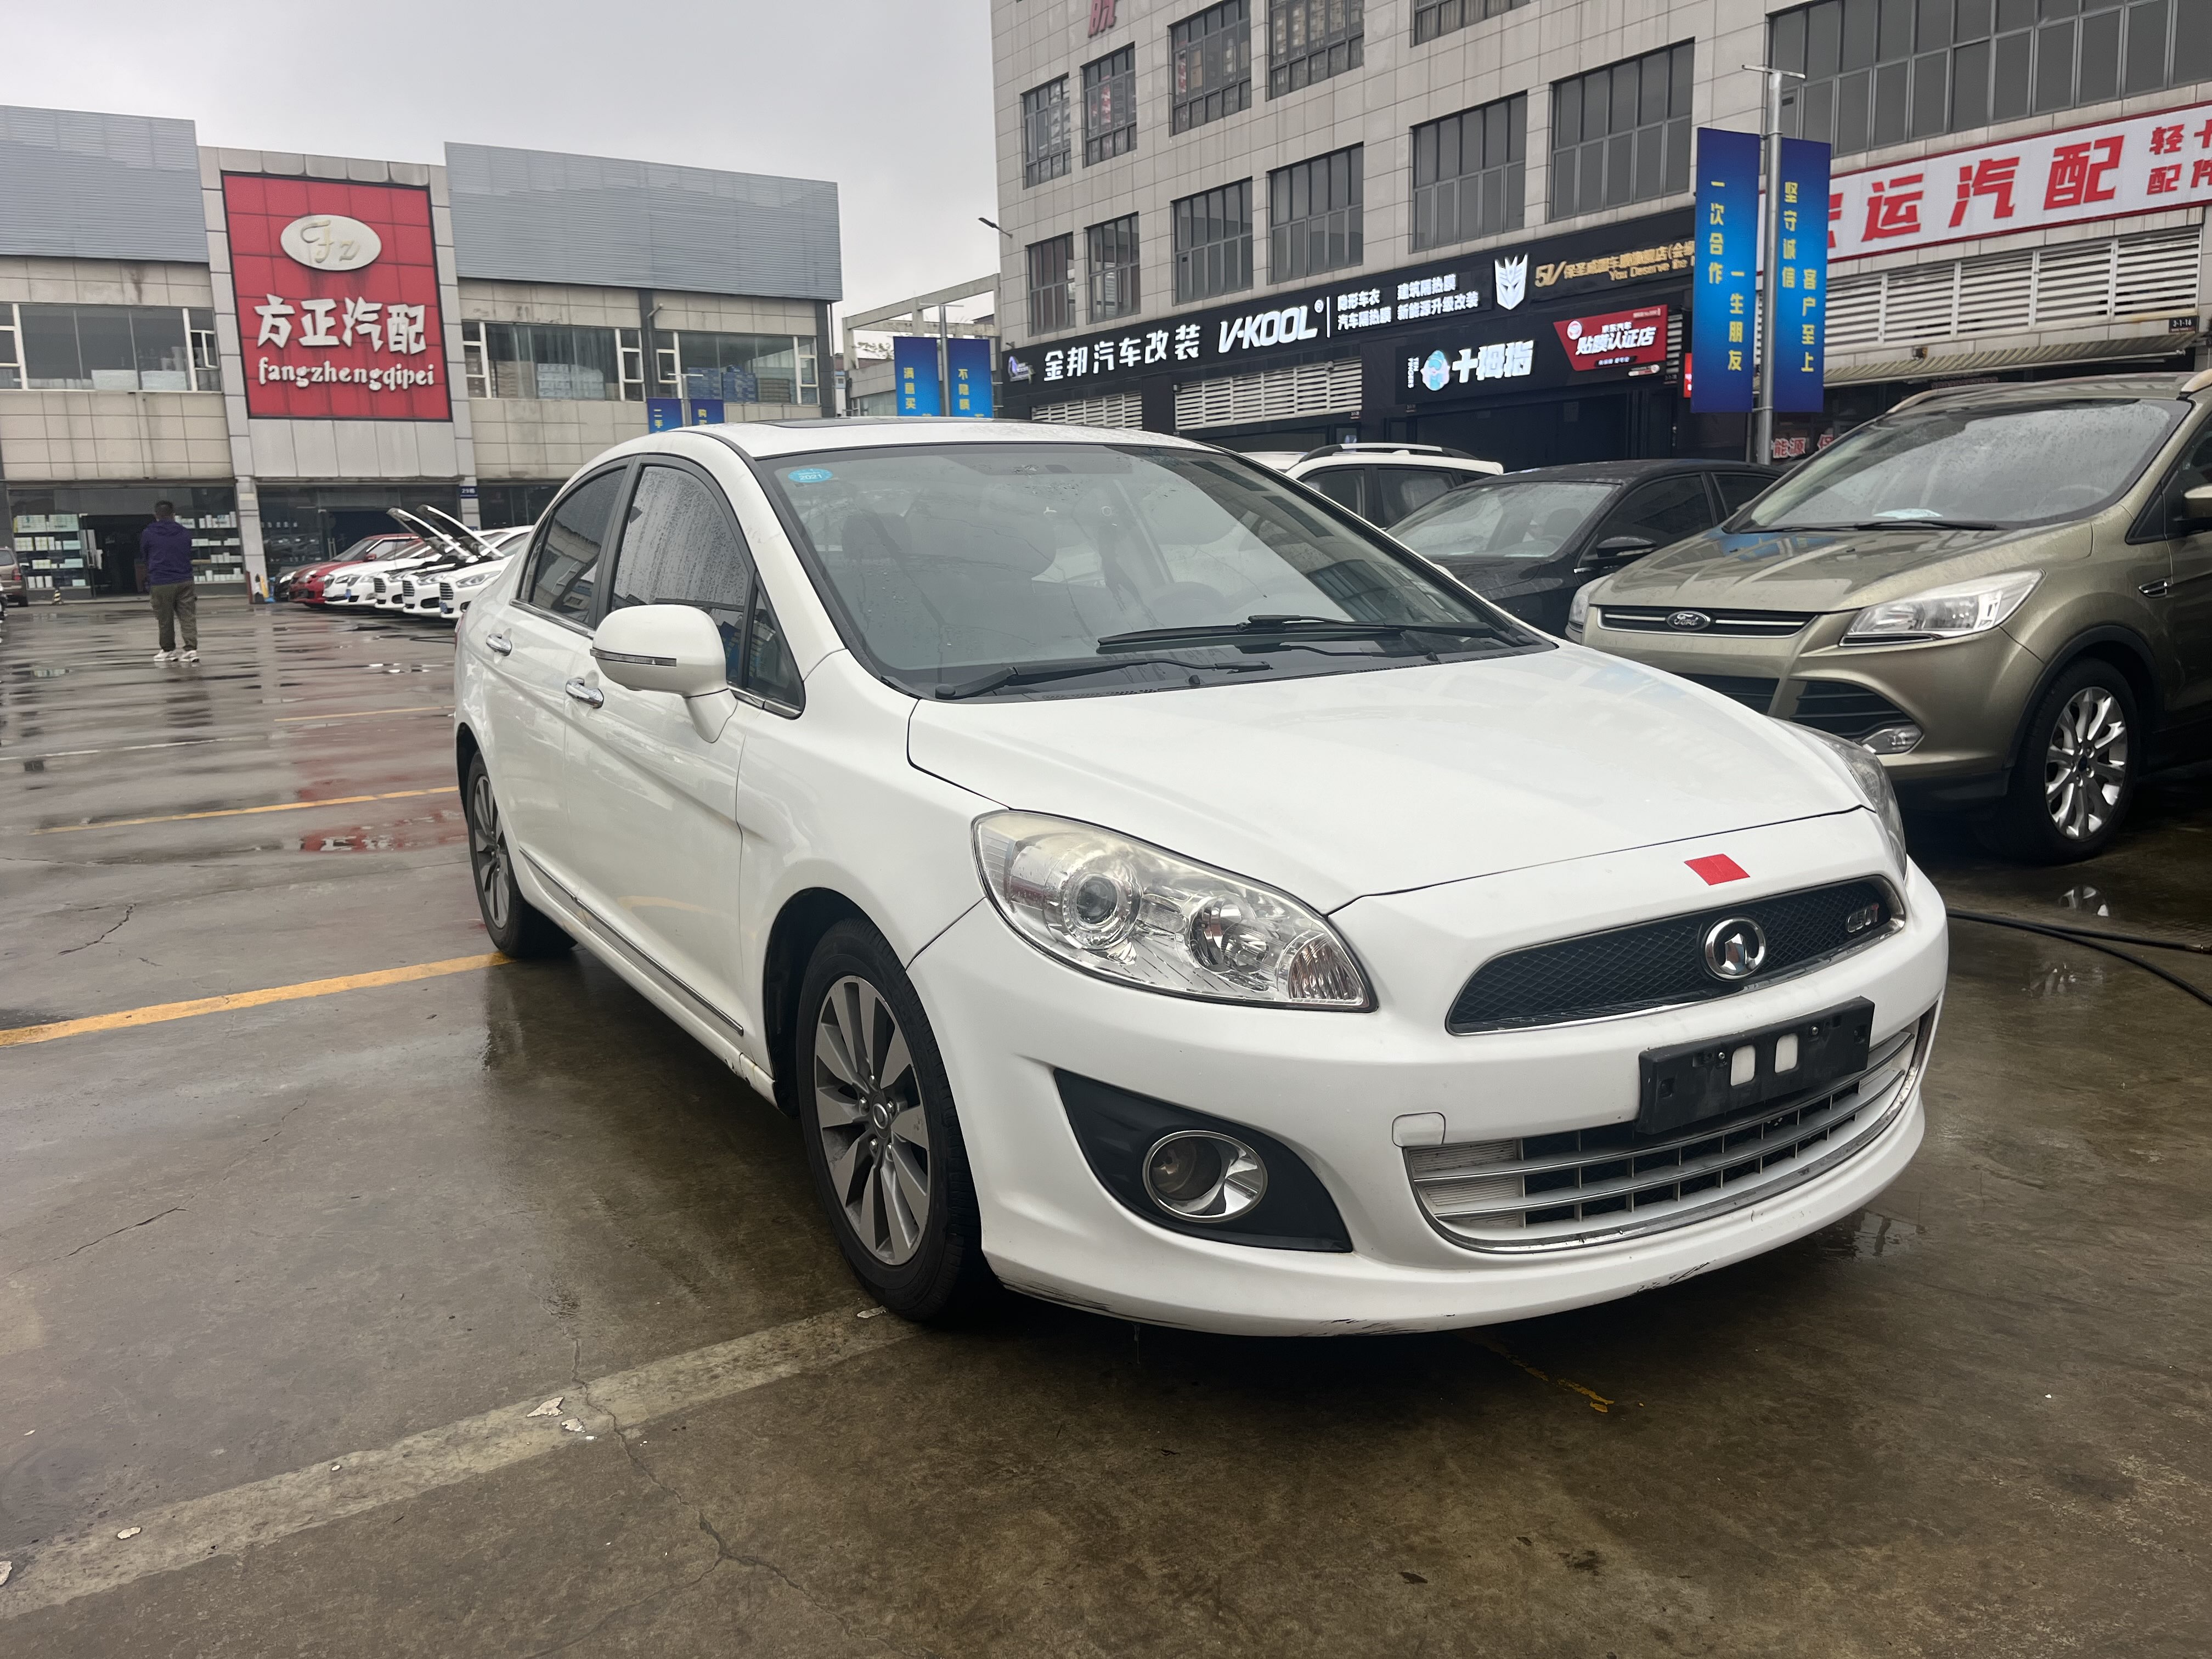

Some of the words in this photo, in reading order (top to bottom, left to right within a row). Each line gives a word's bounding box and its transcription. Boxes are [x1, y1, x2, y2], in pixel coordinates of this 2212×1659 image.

[1709, 181, 1725, 285] 一次合作
[253, 294, 426, 354] 方正汽配
[1397, 290, 1479, 321] 新能源升级改装
[1728, 270, 1745, 371] 一生朋友
[1801, 269, 1818, 373] 客户至上
[258, 357, 435, 391] fangzhengqipei
[1770, 437, 1806, 459] 能源
